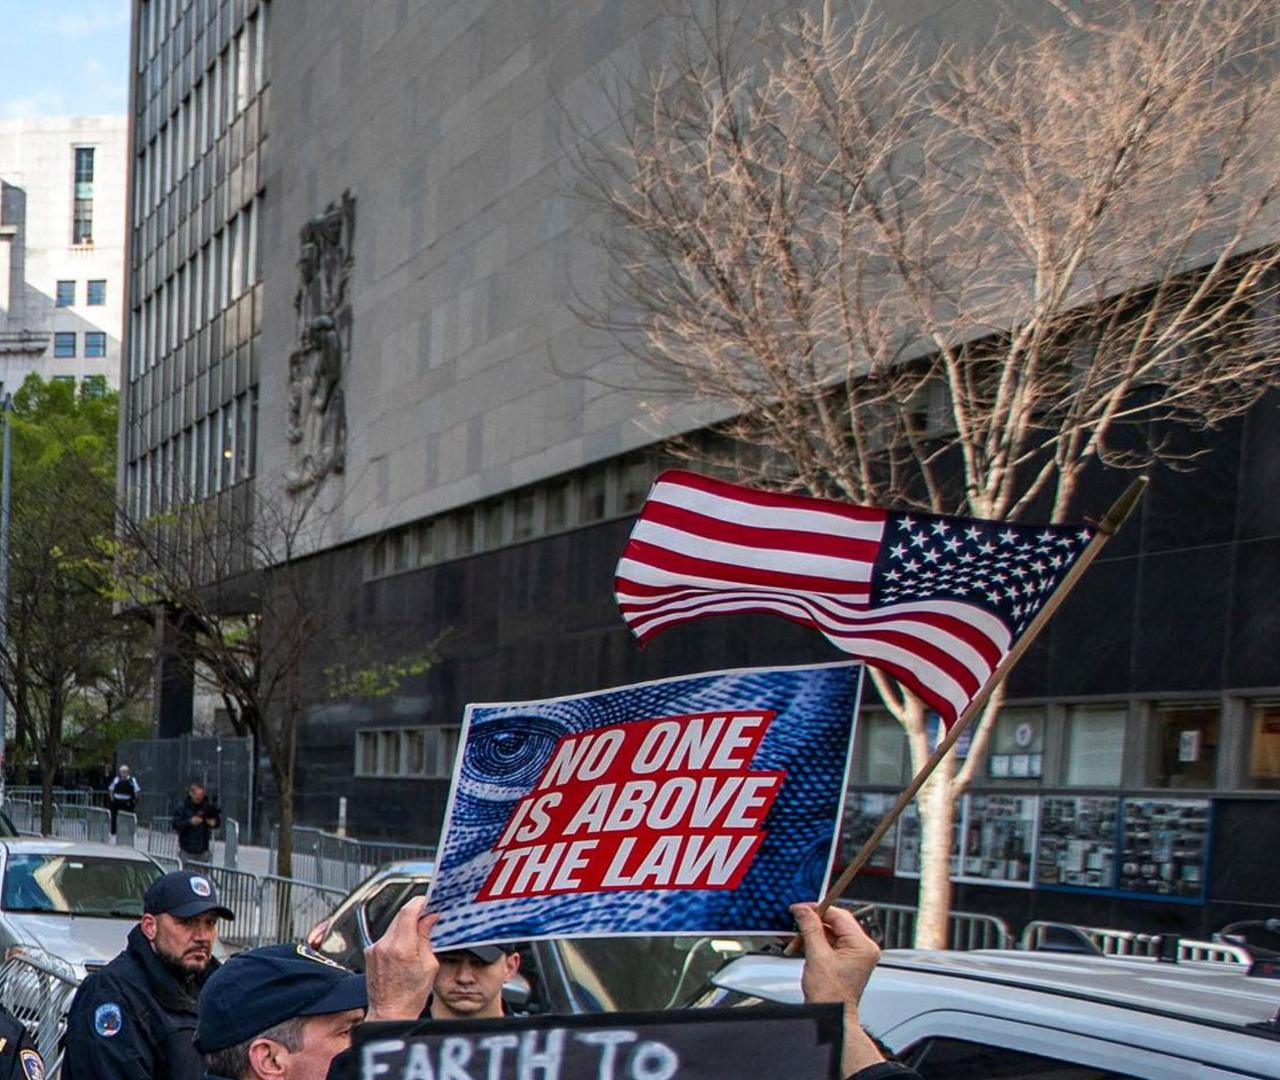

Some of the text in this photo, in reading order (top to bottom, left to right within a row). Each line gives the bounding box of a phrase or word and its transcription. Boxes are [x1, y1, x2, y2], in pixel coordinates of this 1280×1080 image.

[538, 716, 764, 791] NO ONE
[498, 776, 778, 848] IS ABOVE
[490, 835, 758, 897] THE LAW
